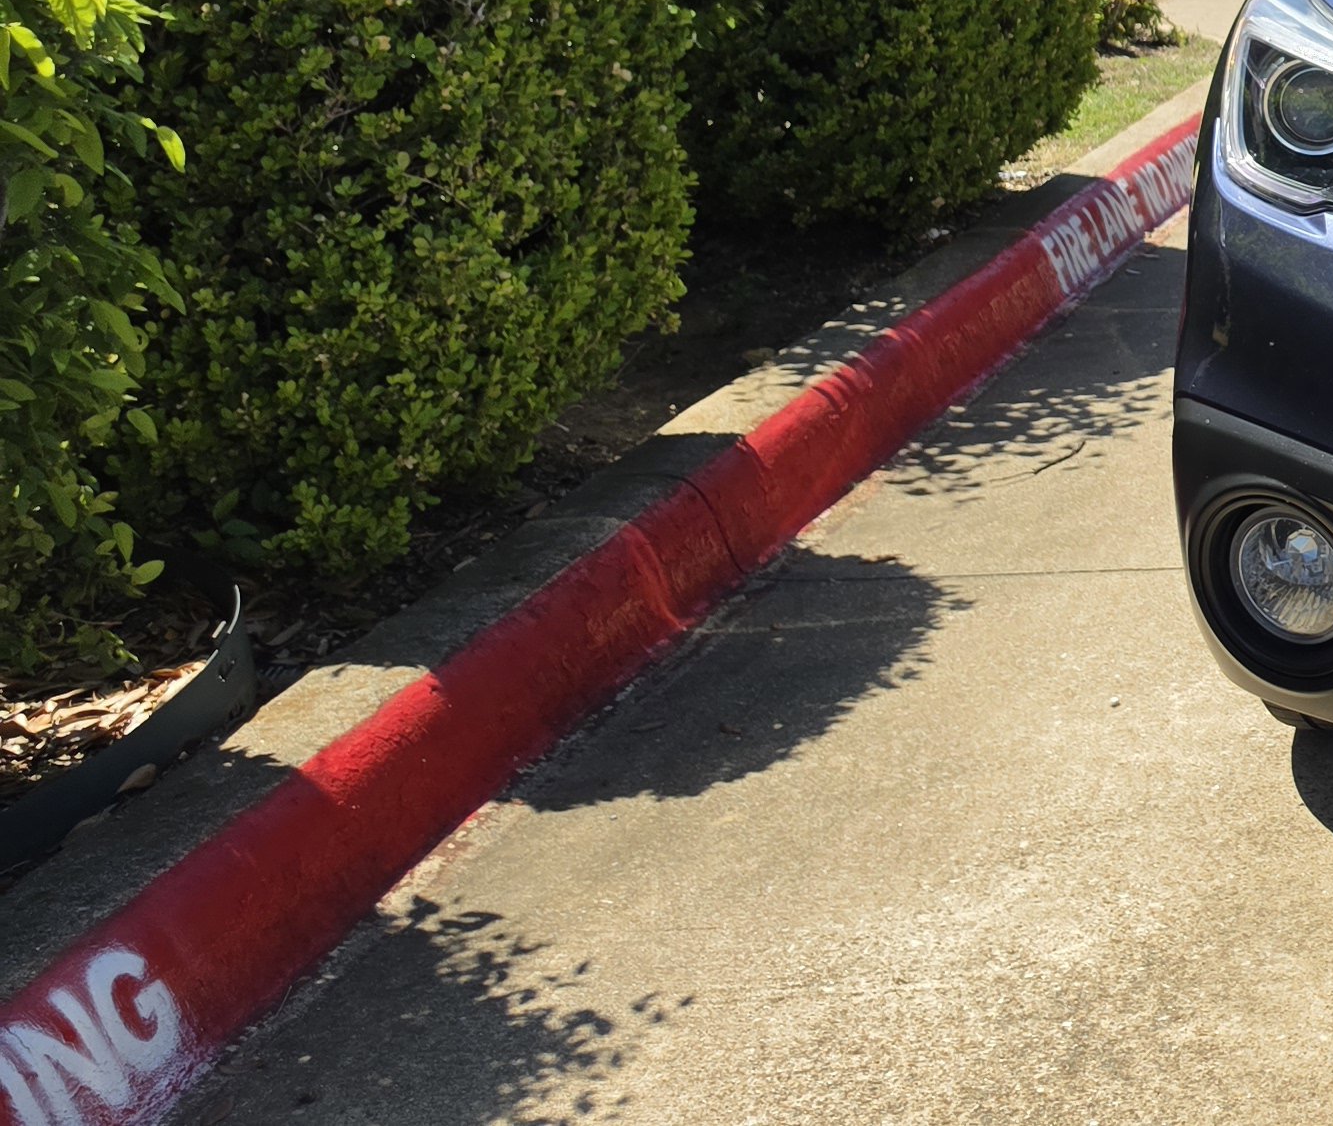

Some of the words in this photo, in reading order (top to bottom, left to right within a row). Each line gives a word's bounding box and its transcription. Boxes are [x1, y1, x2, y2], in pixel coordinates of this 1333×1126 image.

[1041, 215, 1101, 296] FIRE
[1083, 178, 1145, 258] LANE
[1132, 161, 1174, 221] NO
